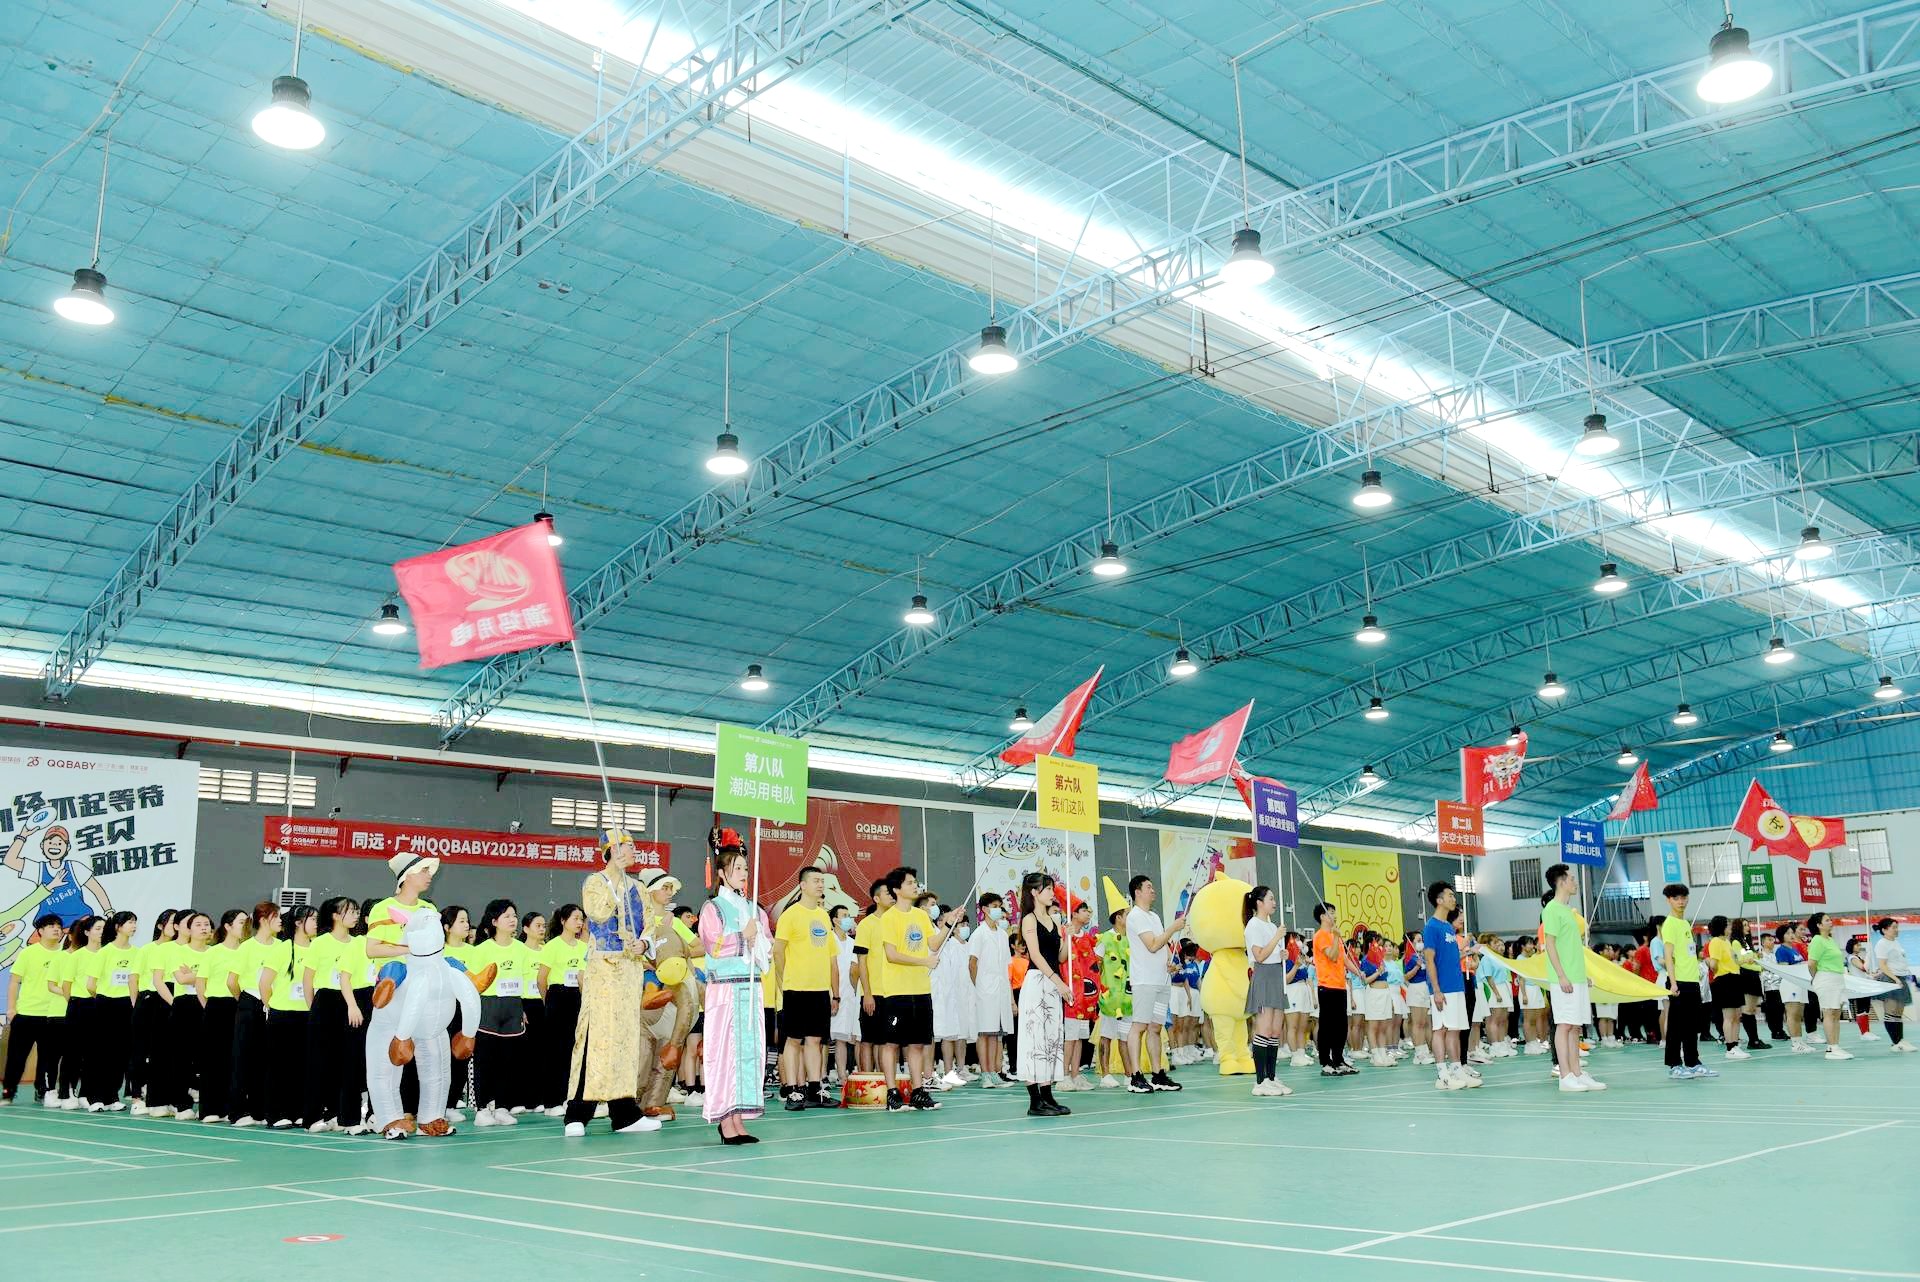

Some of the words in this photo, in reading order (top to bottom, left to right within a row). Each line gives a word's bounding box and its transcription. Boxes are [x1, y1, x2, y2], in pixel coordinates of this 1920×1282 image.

[47, 759, 96, 770] QQBABY
[744, 751, 784, 778] 第八队
[729, 776, 796, 805] 潮妈用电队
[1055, 774, 1082, 794] 第六队
[1051, 796, 1087, 816] 我们这队
[1266, 797, 1288, 816] 第四队
[76, 815, 135, 851] 宝贝
[856, 823, 895, 837] QQBABY
[1451, 816, 1473, 831] 第二队
[1441, 831, 1483, 847] 天空大宝贝队
[1573, 829, 1594, 843] 第一队
[90, 842, 178, 876] 就现在
[1335, 882, 1393, 923] 1999
